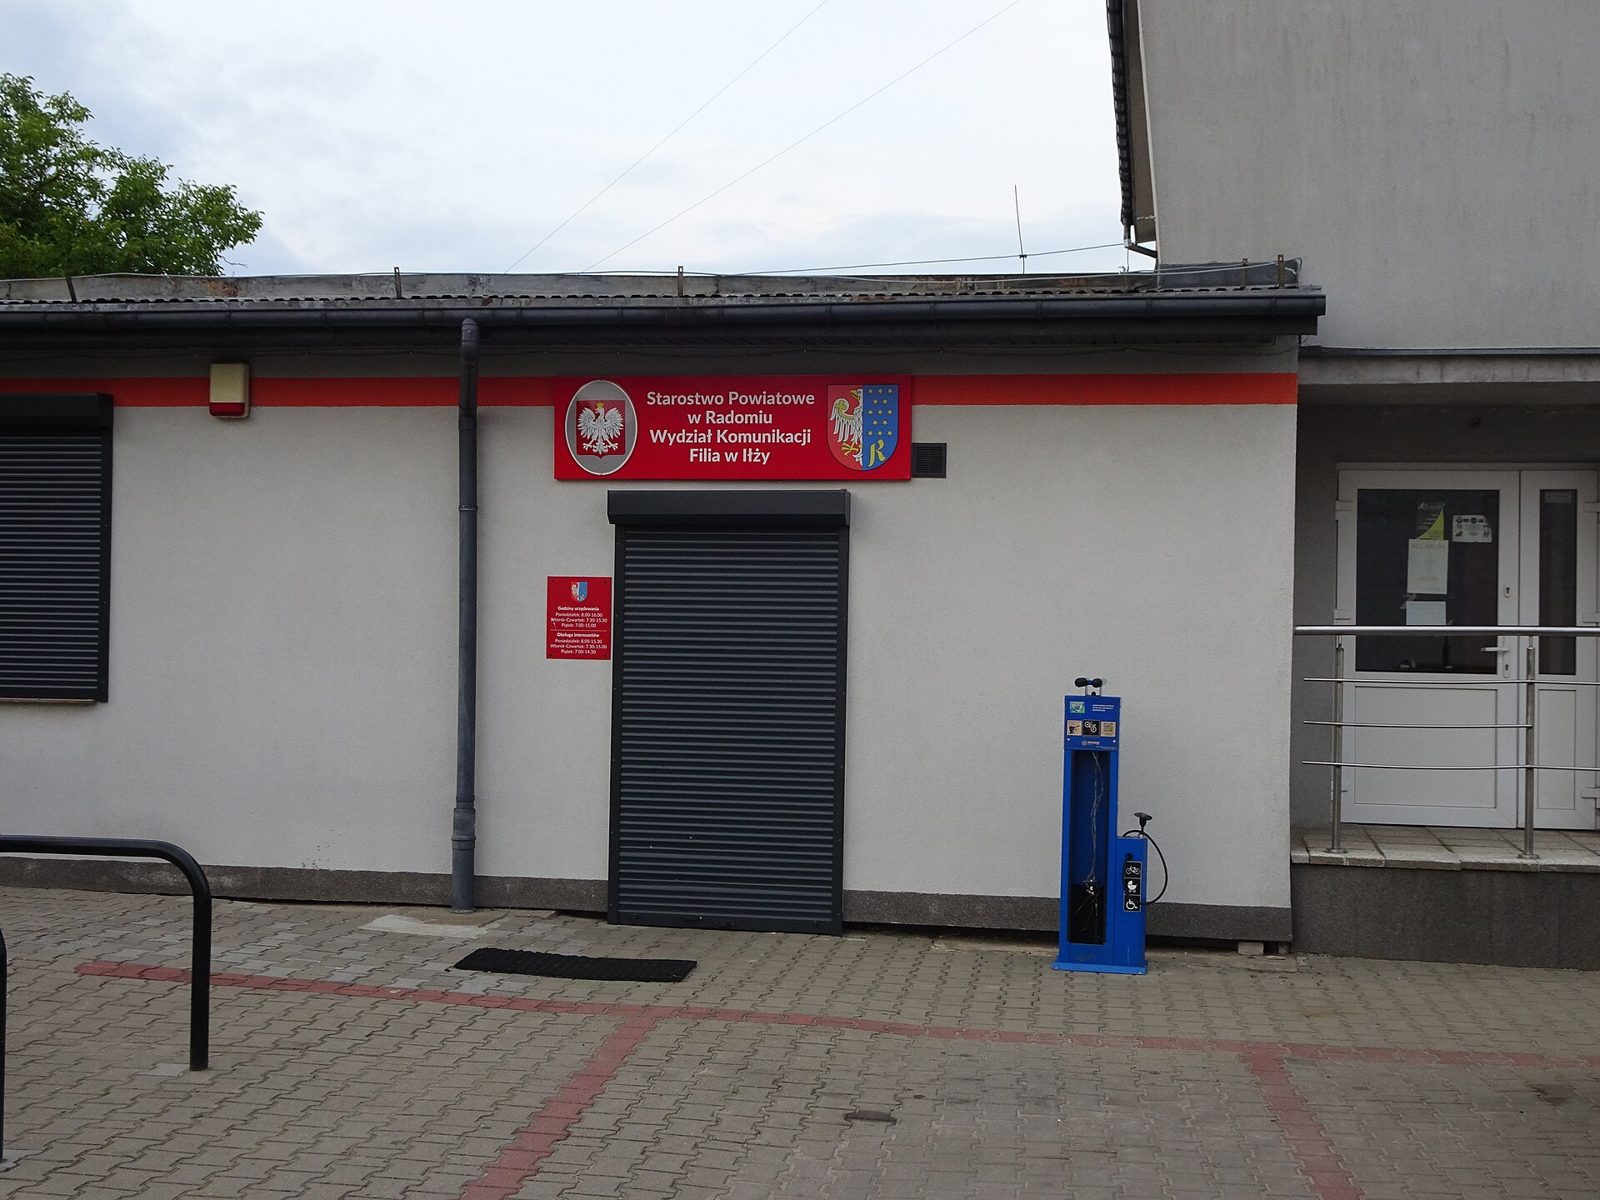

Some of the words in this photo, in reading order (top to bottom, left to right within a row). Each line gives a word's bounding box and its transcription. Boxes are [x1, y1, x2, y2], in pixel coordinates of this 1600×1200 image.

[647, 391, 724, 405] Starostwo
[728, 391, 815, 405] Powiatowe
[688, 413, 702, 424] w
[706, 410, 773, 424] Radomiu
[650, 429, 713, 446] Wydział
[717, 429, 812, 446] Komunikacji
[689, 448, 721, 463] Filia
[724, 452, 738, 463] w
[742, 448, 770, 465] Iłży
